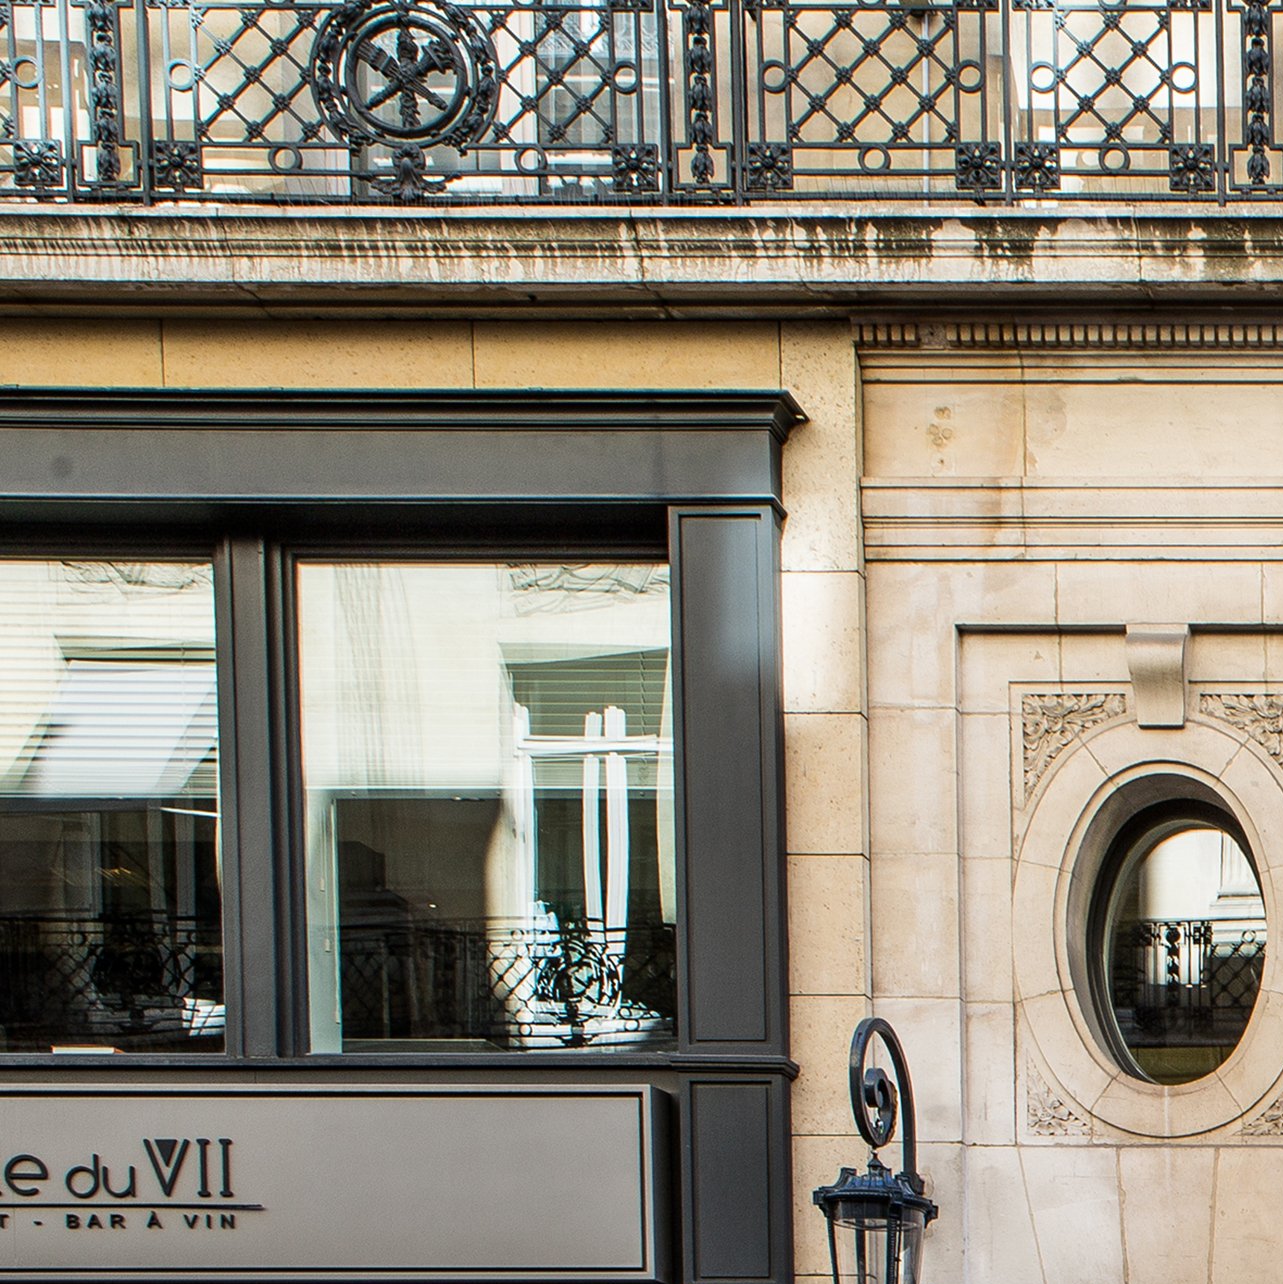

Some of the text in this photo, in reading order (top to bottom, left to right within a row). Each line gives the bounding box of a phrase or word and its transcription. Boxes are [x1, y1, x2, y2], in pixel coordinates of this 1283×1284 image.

[0, 1138, 237, 1199] e du VII
[65, 1213, 127, 1230] BAR
[146, 1210, 164, 1230] À
[183, 1213, 237, 1230] VIN
